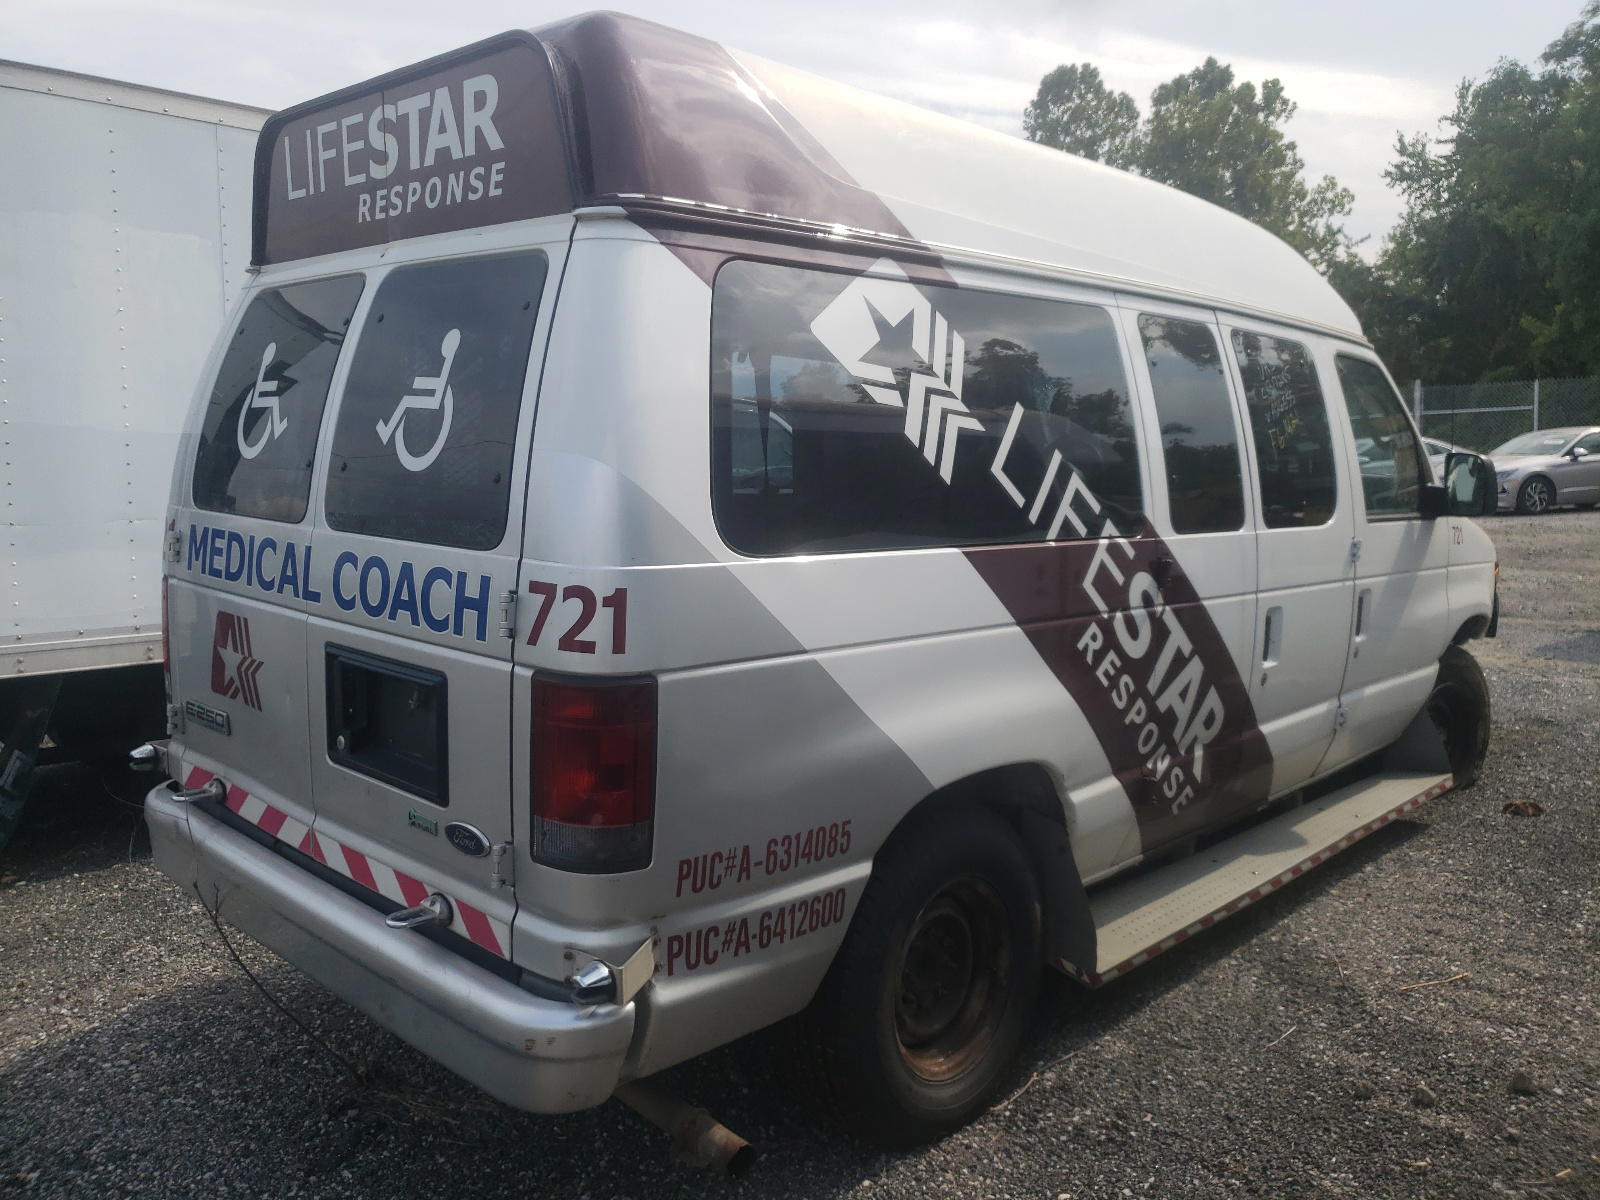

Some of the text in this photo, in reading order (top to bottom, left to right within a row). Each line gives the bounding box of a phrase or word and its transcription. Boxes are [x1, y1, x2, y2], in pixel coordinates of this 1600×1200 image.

[284, 74, 504, 200] LIFESTAR
[358, 162, 505, 223] RESPONSE
[1451, 525, 1465, 545] 721
[187, 523, 492, 643] MEDICAL COACH
[527, 580, 629, 655] 721
[990, 401, 1225, 785] LIFESTAR
[1076, 622, 1196, 816] RESPONSE
[675, 819, 853, 898] PUC#A-6314085
[667, 887, 847, 977] PUC#A-6412600
